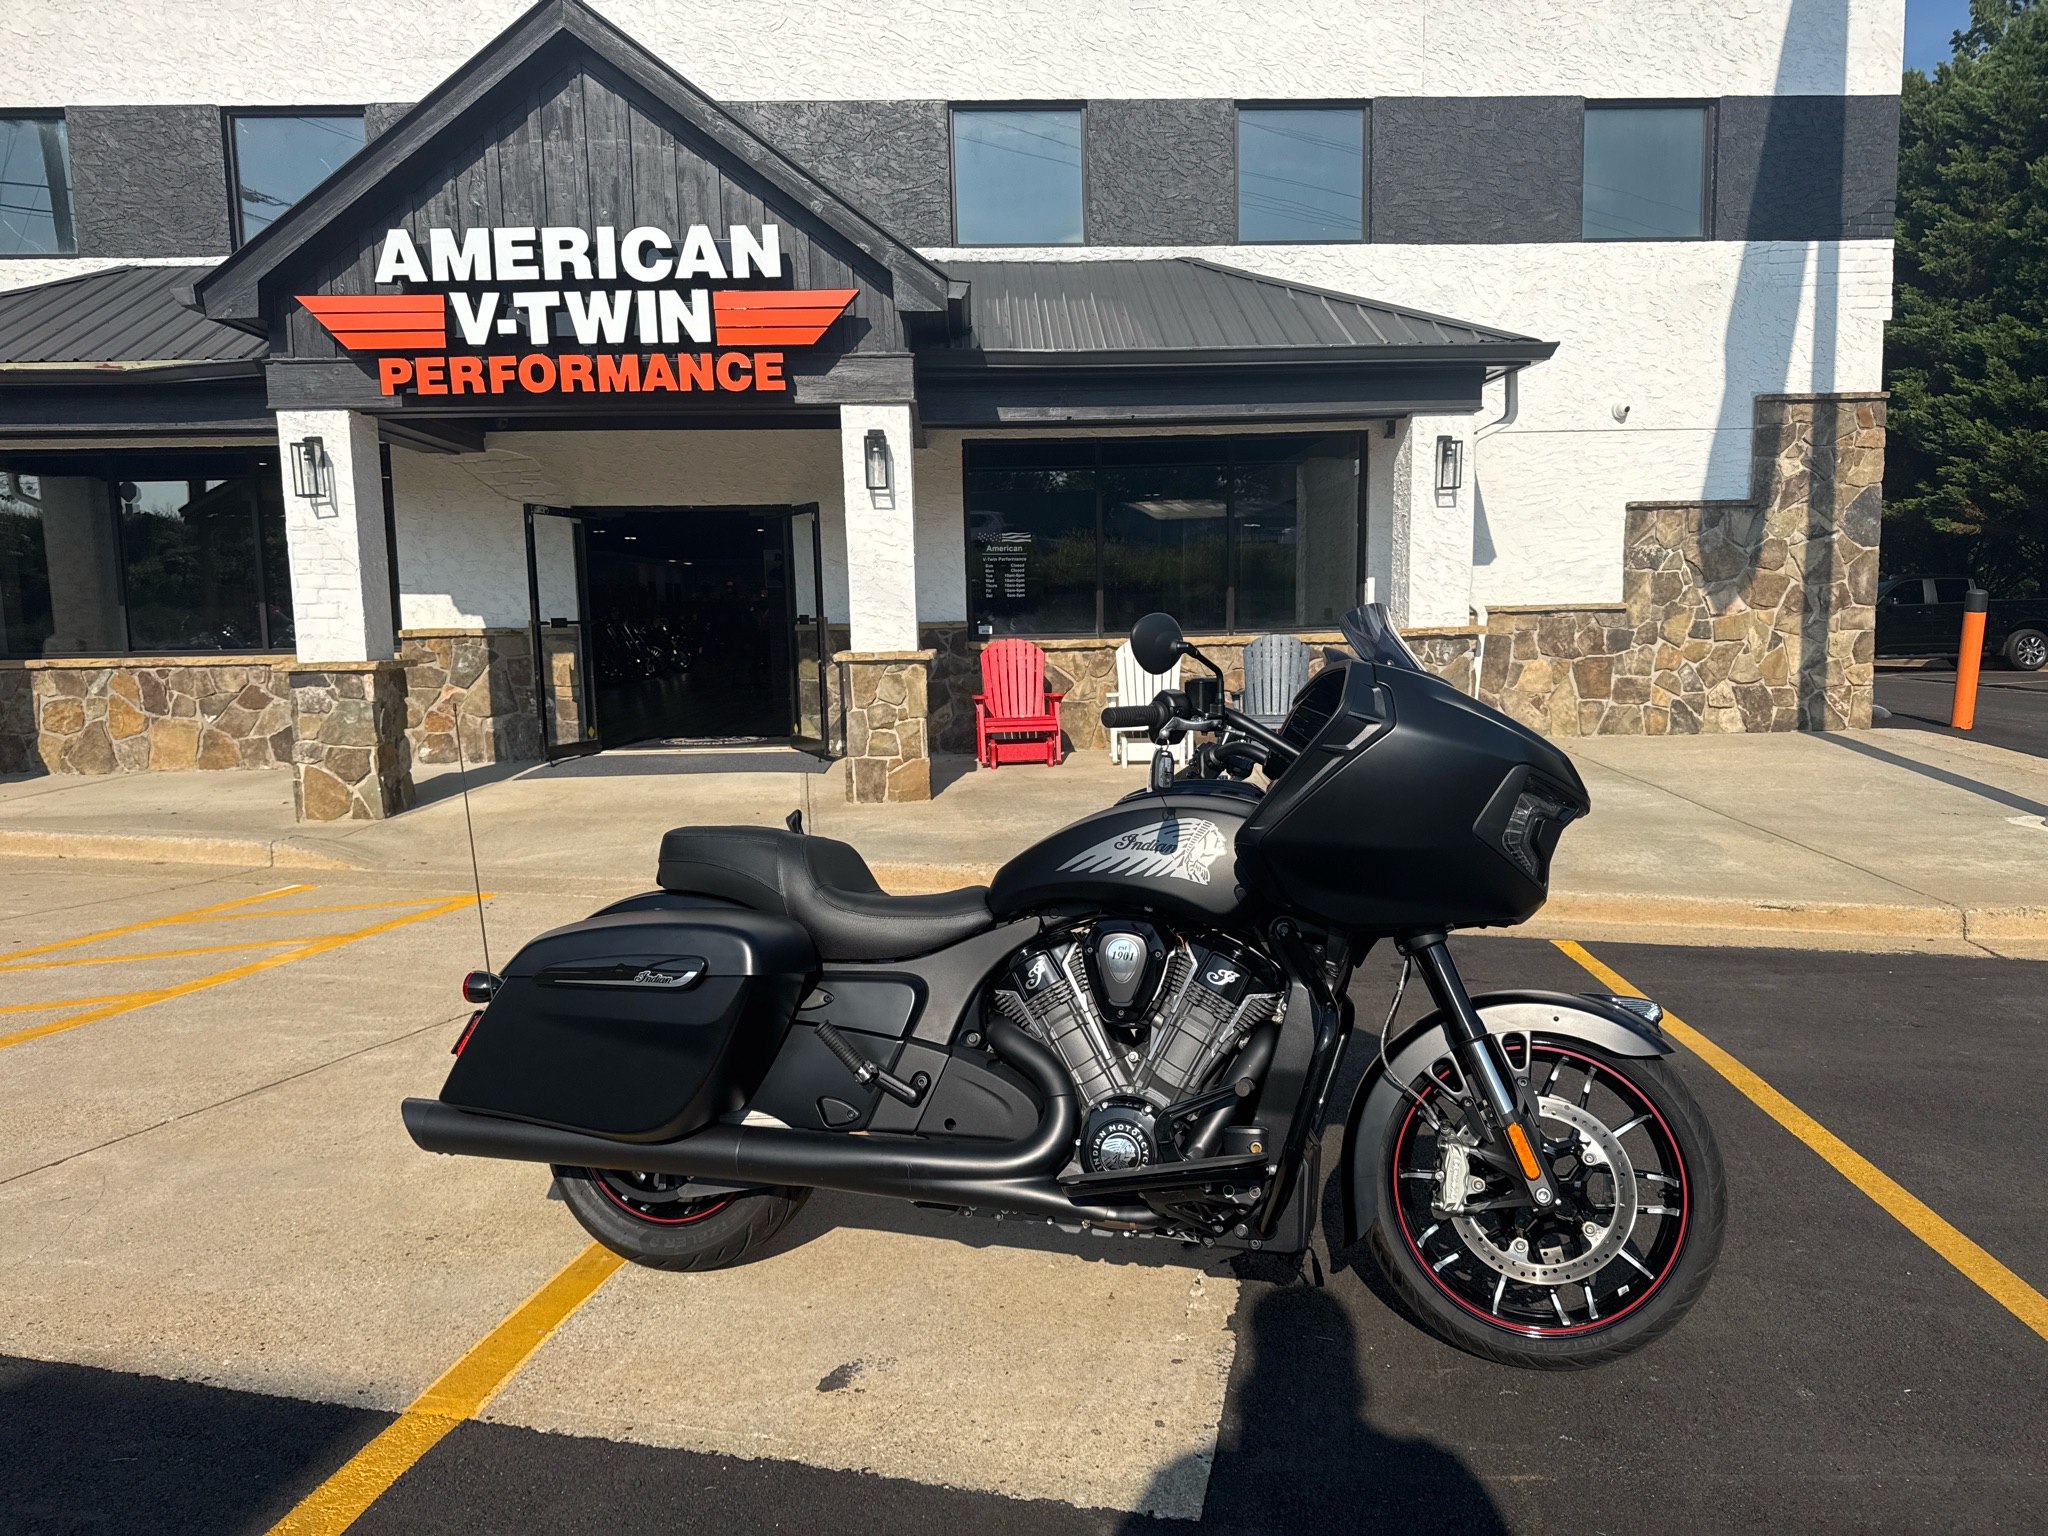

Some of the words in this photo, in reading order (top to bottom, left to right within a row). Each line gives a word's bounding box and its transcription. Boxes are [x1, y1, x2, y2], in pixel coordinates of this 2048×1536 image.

[374, 223, 782, 283] AMERICAN
[448, 288, 712, 347] V-TWIN
[378, 352, 787, 396] PERFORMANCE
[1114, 833, 1178, 854] Indian
[1112, 951, 1134, 961] 1901
[634, 970, 673, 984] Indian
[1092, 1130, 1107, 1170] INDIAN
[1513, 1335, 1609, 1352] METZELER
